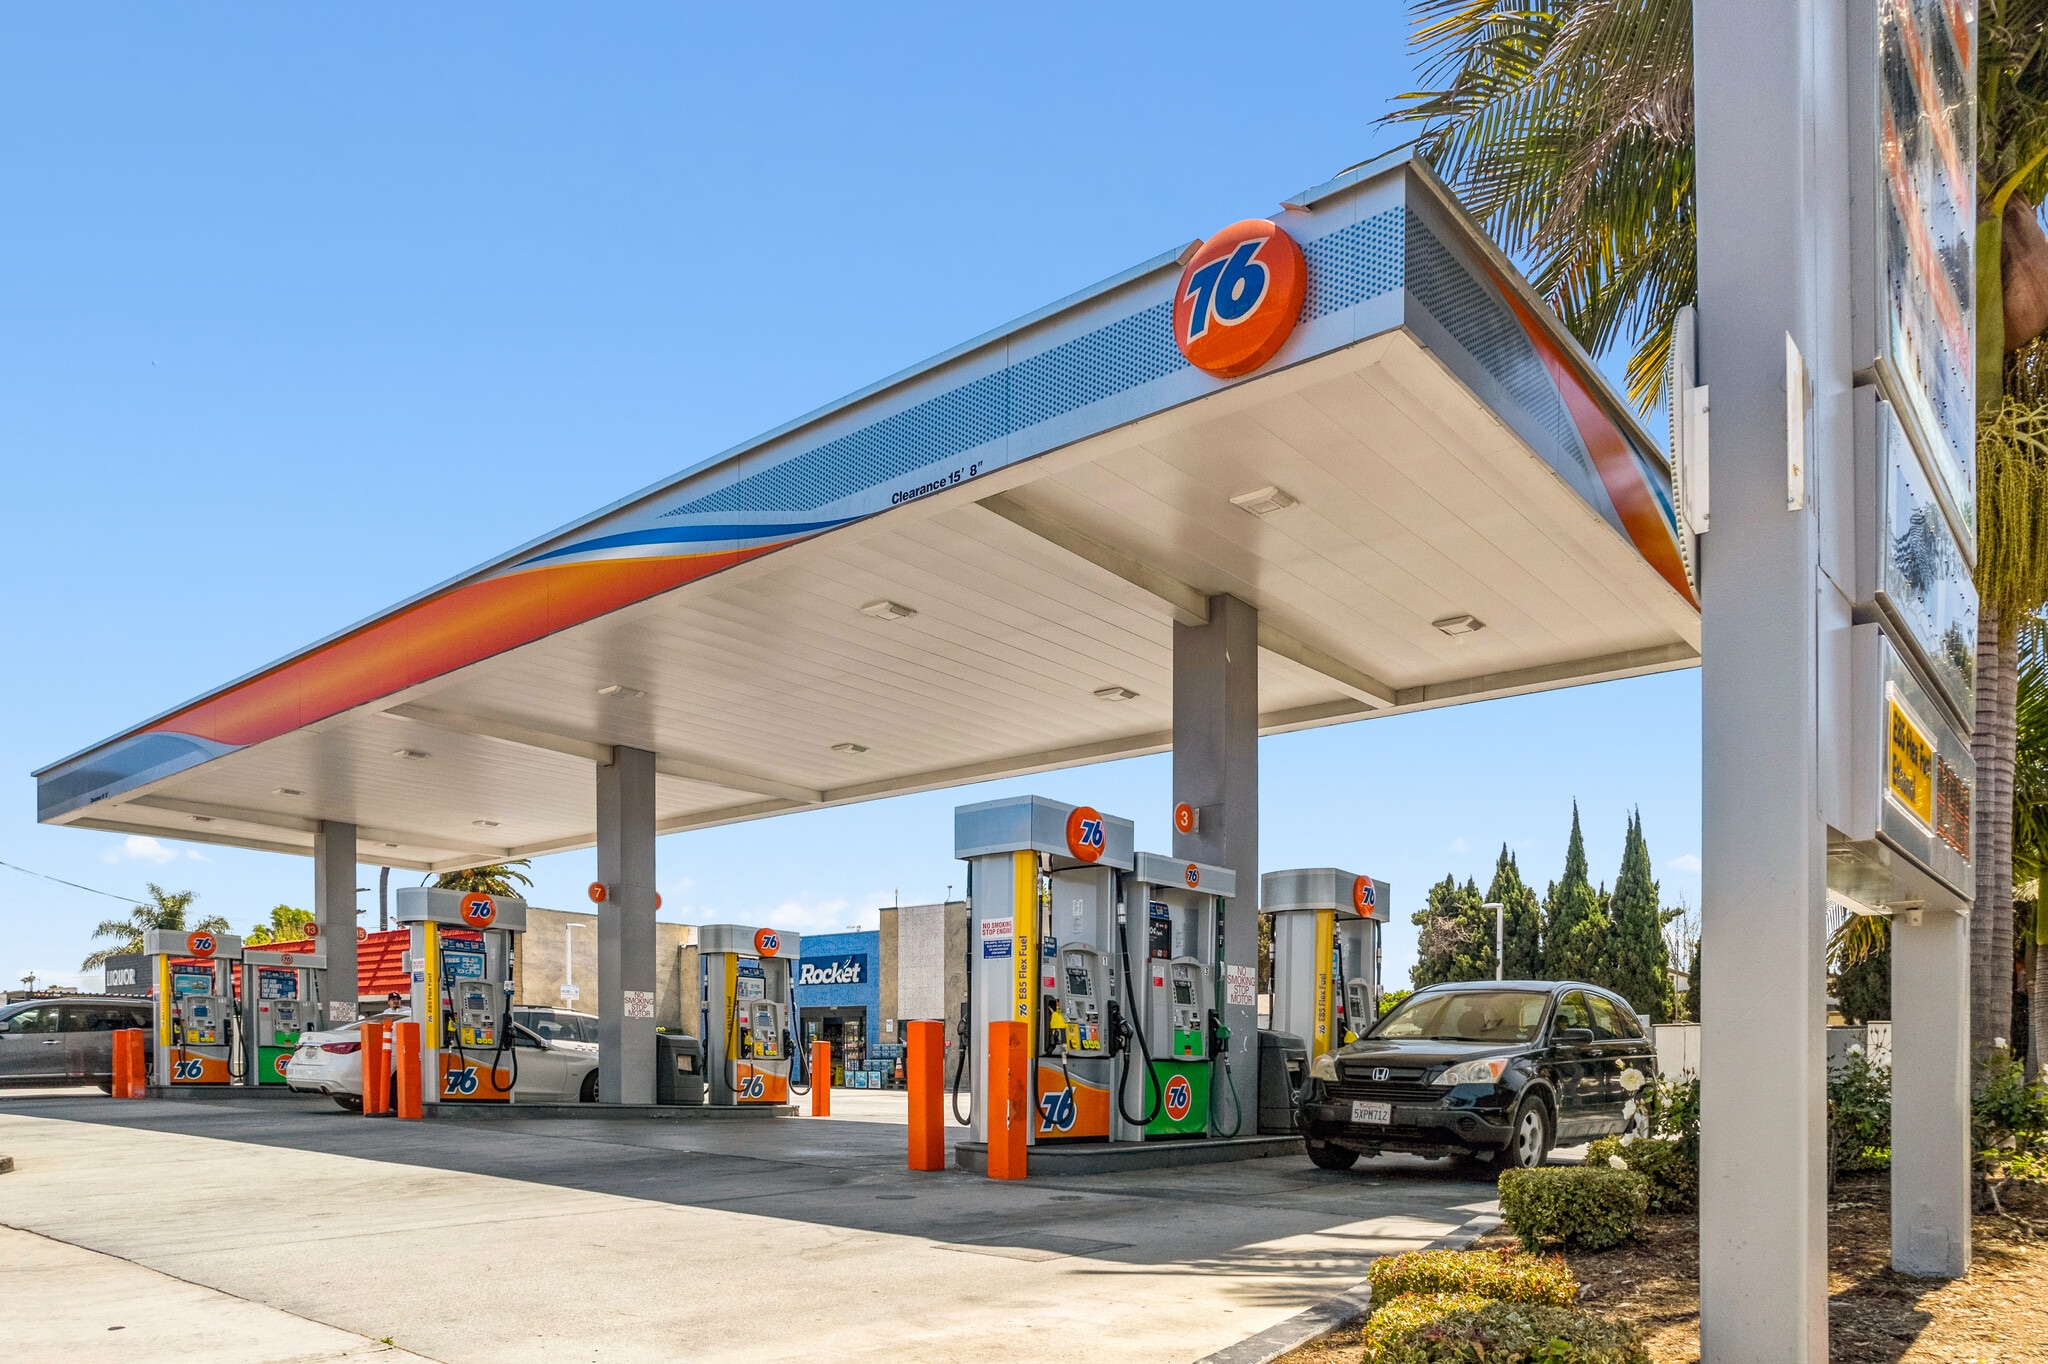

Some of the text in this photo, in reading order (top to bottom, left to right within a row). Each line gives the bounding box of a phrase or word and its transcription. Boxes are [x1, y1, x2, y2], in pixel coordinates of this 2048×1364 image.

[1183, 236, 1270, 345] 76
[892, 477, 946, 504] Clearance
[1180, 810, 1189, 826] 3
[1079, 818, 1104, 848] 76
[1187, 869, 1197, 882] 76
[594, 887, 602, 898] 7
[1362, 885, 1376, 907] 76
[469, 900, 491, 919] 76
[306, 925, 316, 934] 13
[991, 920, 1012, 928] SMOKING
[996, 927, 1012, 935] ENGINE
[194, 938, 212, 950] 76
[761, 935, 777, 949] 76
[282, 955, 292, 963] 76
[107, 968, 136, 986] LIQUOR
[799, 962, 861, 985] Rocket
[1019, 935, 1028, 1017] 76 E85 Flex Fuel
[1236, 966, 1247, 976] NO
[1227, 975, 1256, 987] SMOKING
[1318, 973, 1326, 991] Fuel
[1234, 985, 1250, 994] STOP
[624, 997, 654, 1005] SMOKING
[1230, 993, 1253, 1005] MOTOR
[1318, 992, 1326, 1007] Flex
[1319, 1024, 1326, 1035] 76
[174, 1059, 203, 1080] 76
[444, 1066, 479, 1095] 76
[740, 1075, 765, 1099] 76
[1168, 1083, 1189, 1109] 76
[1040, 1086, 1077, 1132] 76
[1353, 1108, 1388, 1121] 5XPM712
